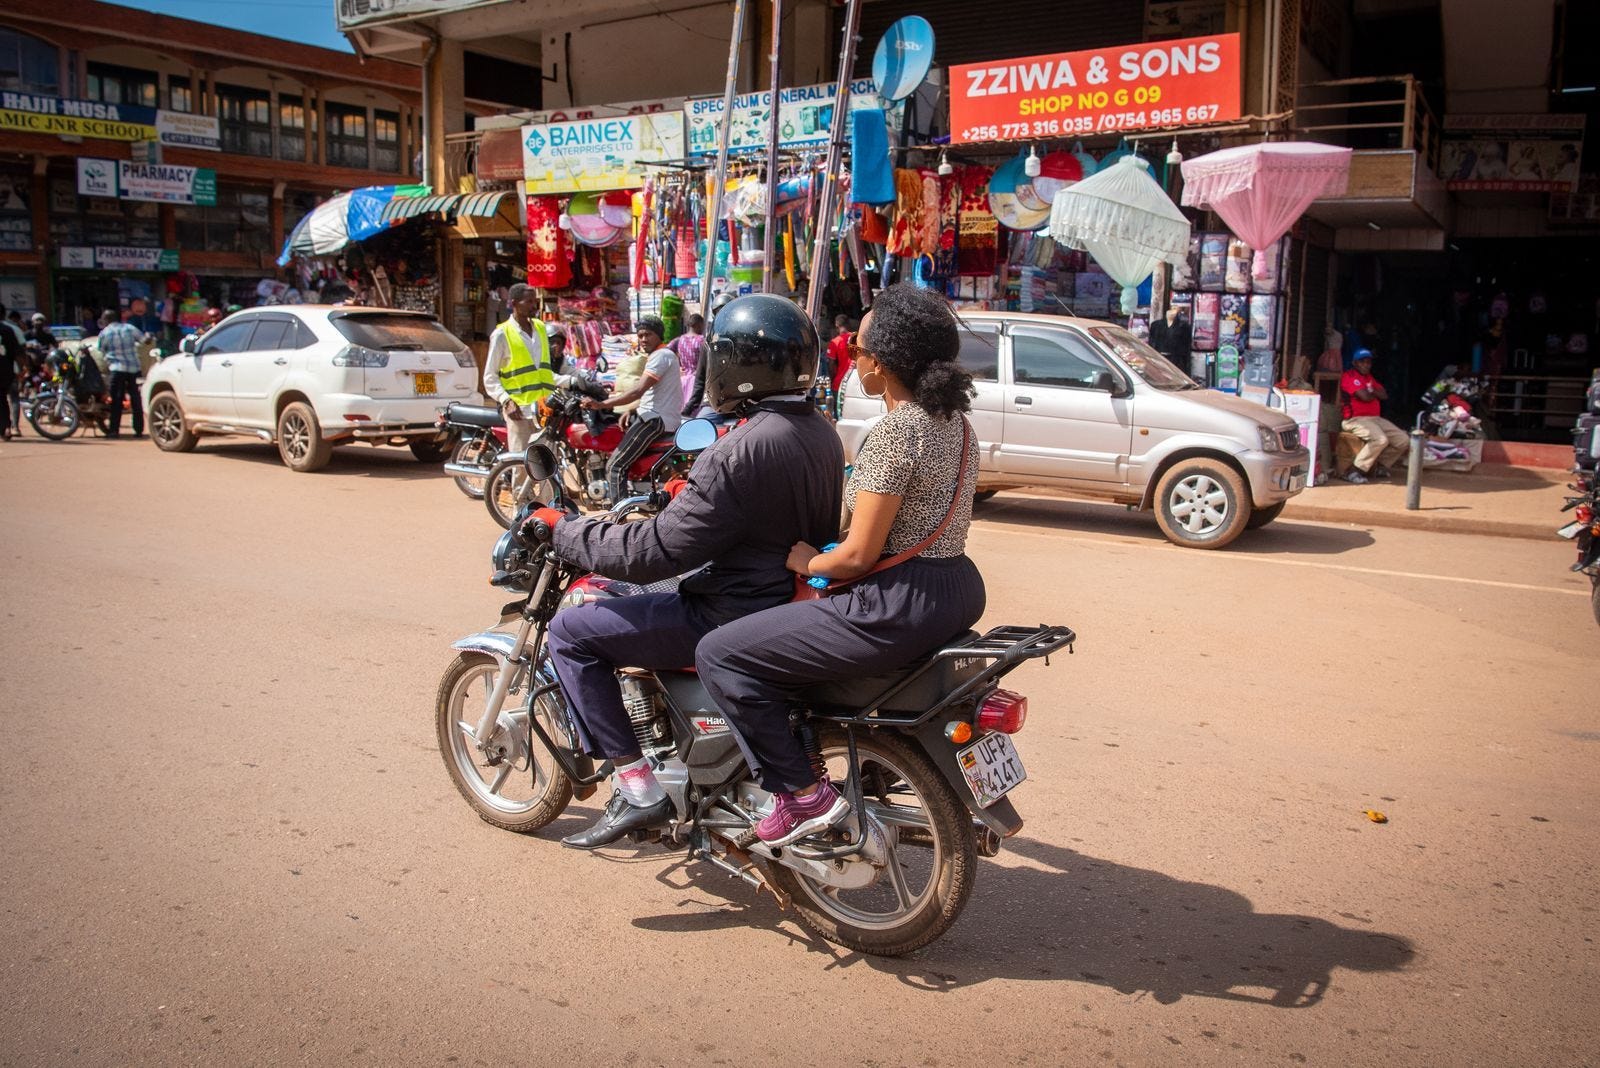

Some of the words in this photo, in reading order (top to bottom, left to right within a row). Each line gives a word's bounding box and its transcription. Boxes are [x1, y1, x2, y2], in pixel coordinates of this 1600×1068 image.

[966, 59, 1077, 98] ZZIWA
[1086, 55, 1109, 85] &
[1119, 42, 1221, 81] SONS
[2, 92, 58, 114] HAJJI
[62, 99, 120, 121] MUSA
[693, 94, 759, 115] SPECRUM
[763, 86, 824, 106] GNERAL
[1019, 95, 1073, 116] SHOP
[1078, 91, 1108, 110] NO
[1114, 88, 1128, 106] G
[1134, 85, 1161, 105] 09
[0, 112, 40, 129] MIC
[45, 116, 79, 133] JNR
[82, 119, 146, 139] SCHOOL
[550, 120, 633, 147] BAINEX
[962, 125, 998, 141] +256
[1002, 122, 1029, 138] 773
[1033, 119, 1059, 135] 316
[1063, 116, 1093, 132] 035
[1097, 111, 1146, 131] /0754
[1150, 107, 1182, 124] 965
[1186, 104, 1219, 120] 667
[551, 144, 613, 157] ENTERPRISES
[616, 142, 633, 151] LTD
[122, 164, 193, 182] PHARMACY
[98, 248, 159, 259] PHARMACY
[978, 733, 1007, 766] UFP
